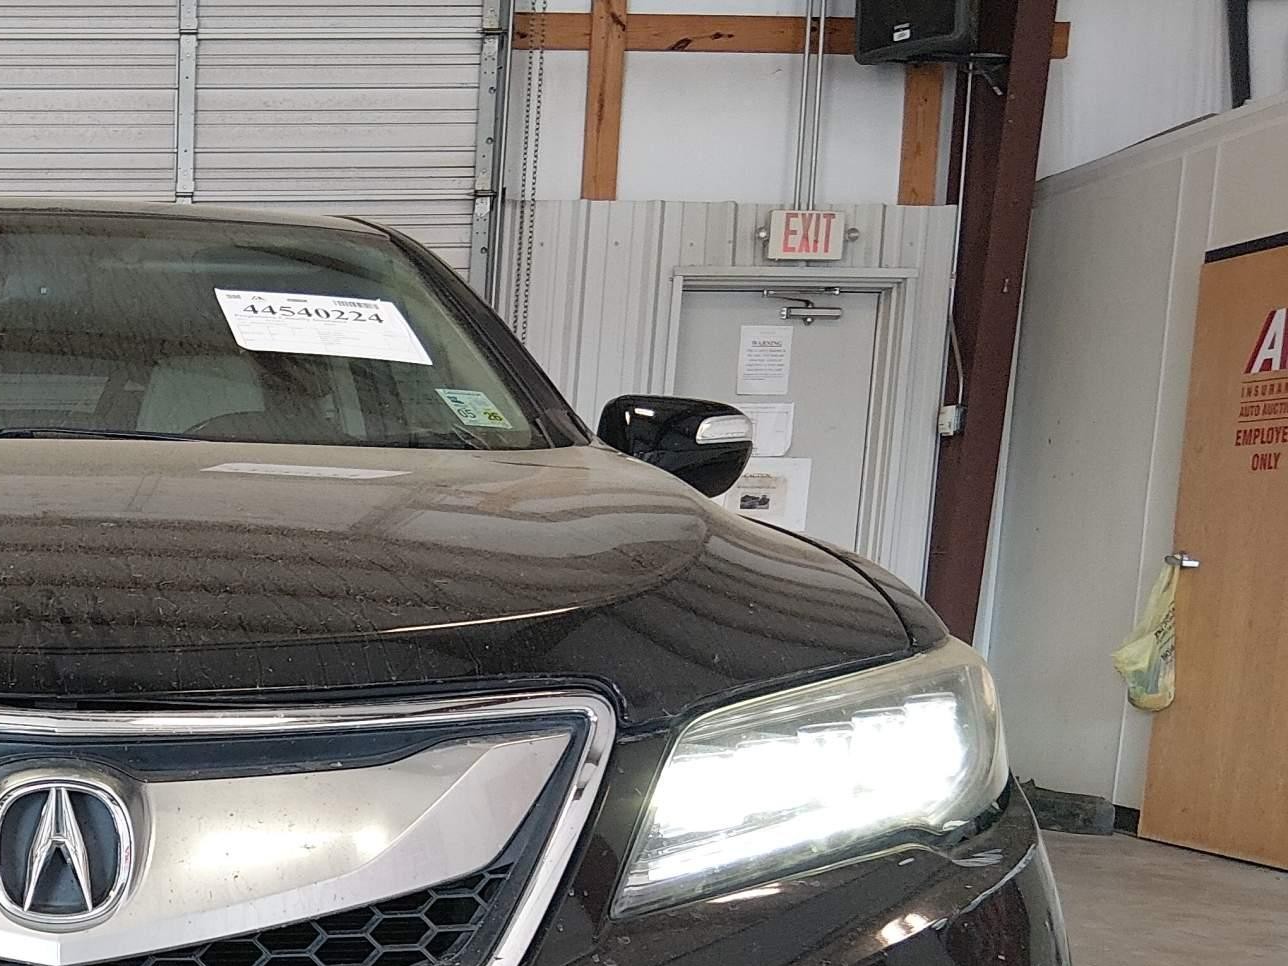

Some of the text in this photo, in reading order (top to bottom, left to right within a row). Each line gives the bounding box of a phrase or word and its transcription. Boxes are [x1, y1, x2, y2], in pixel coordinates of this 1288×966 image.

[782, 212, 837, 253] EXIT
[242, 303, 385, 324] 44540224
[457, 407, 504, 422] 05 26
[1239, 404, 1261, 418] AUTO
[1251, 452, 1281, 472] ONLY
